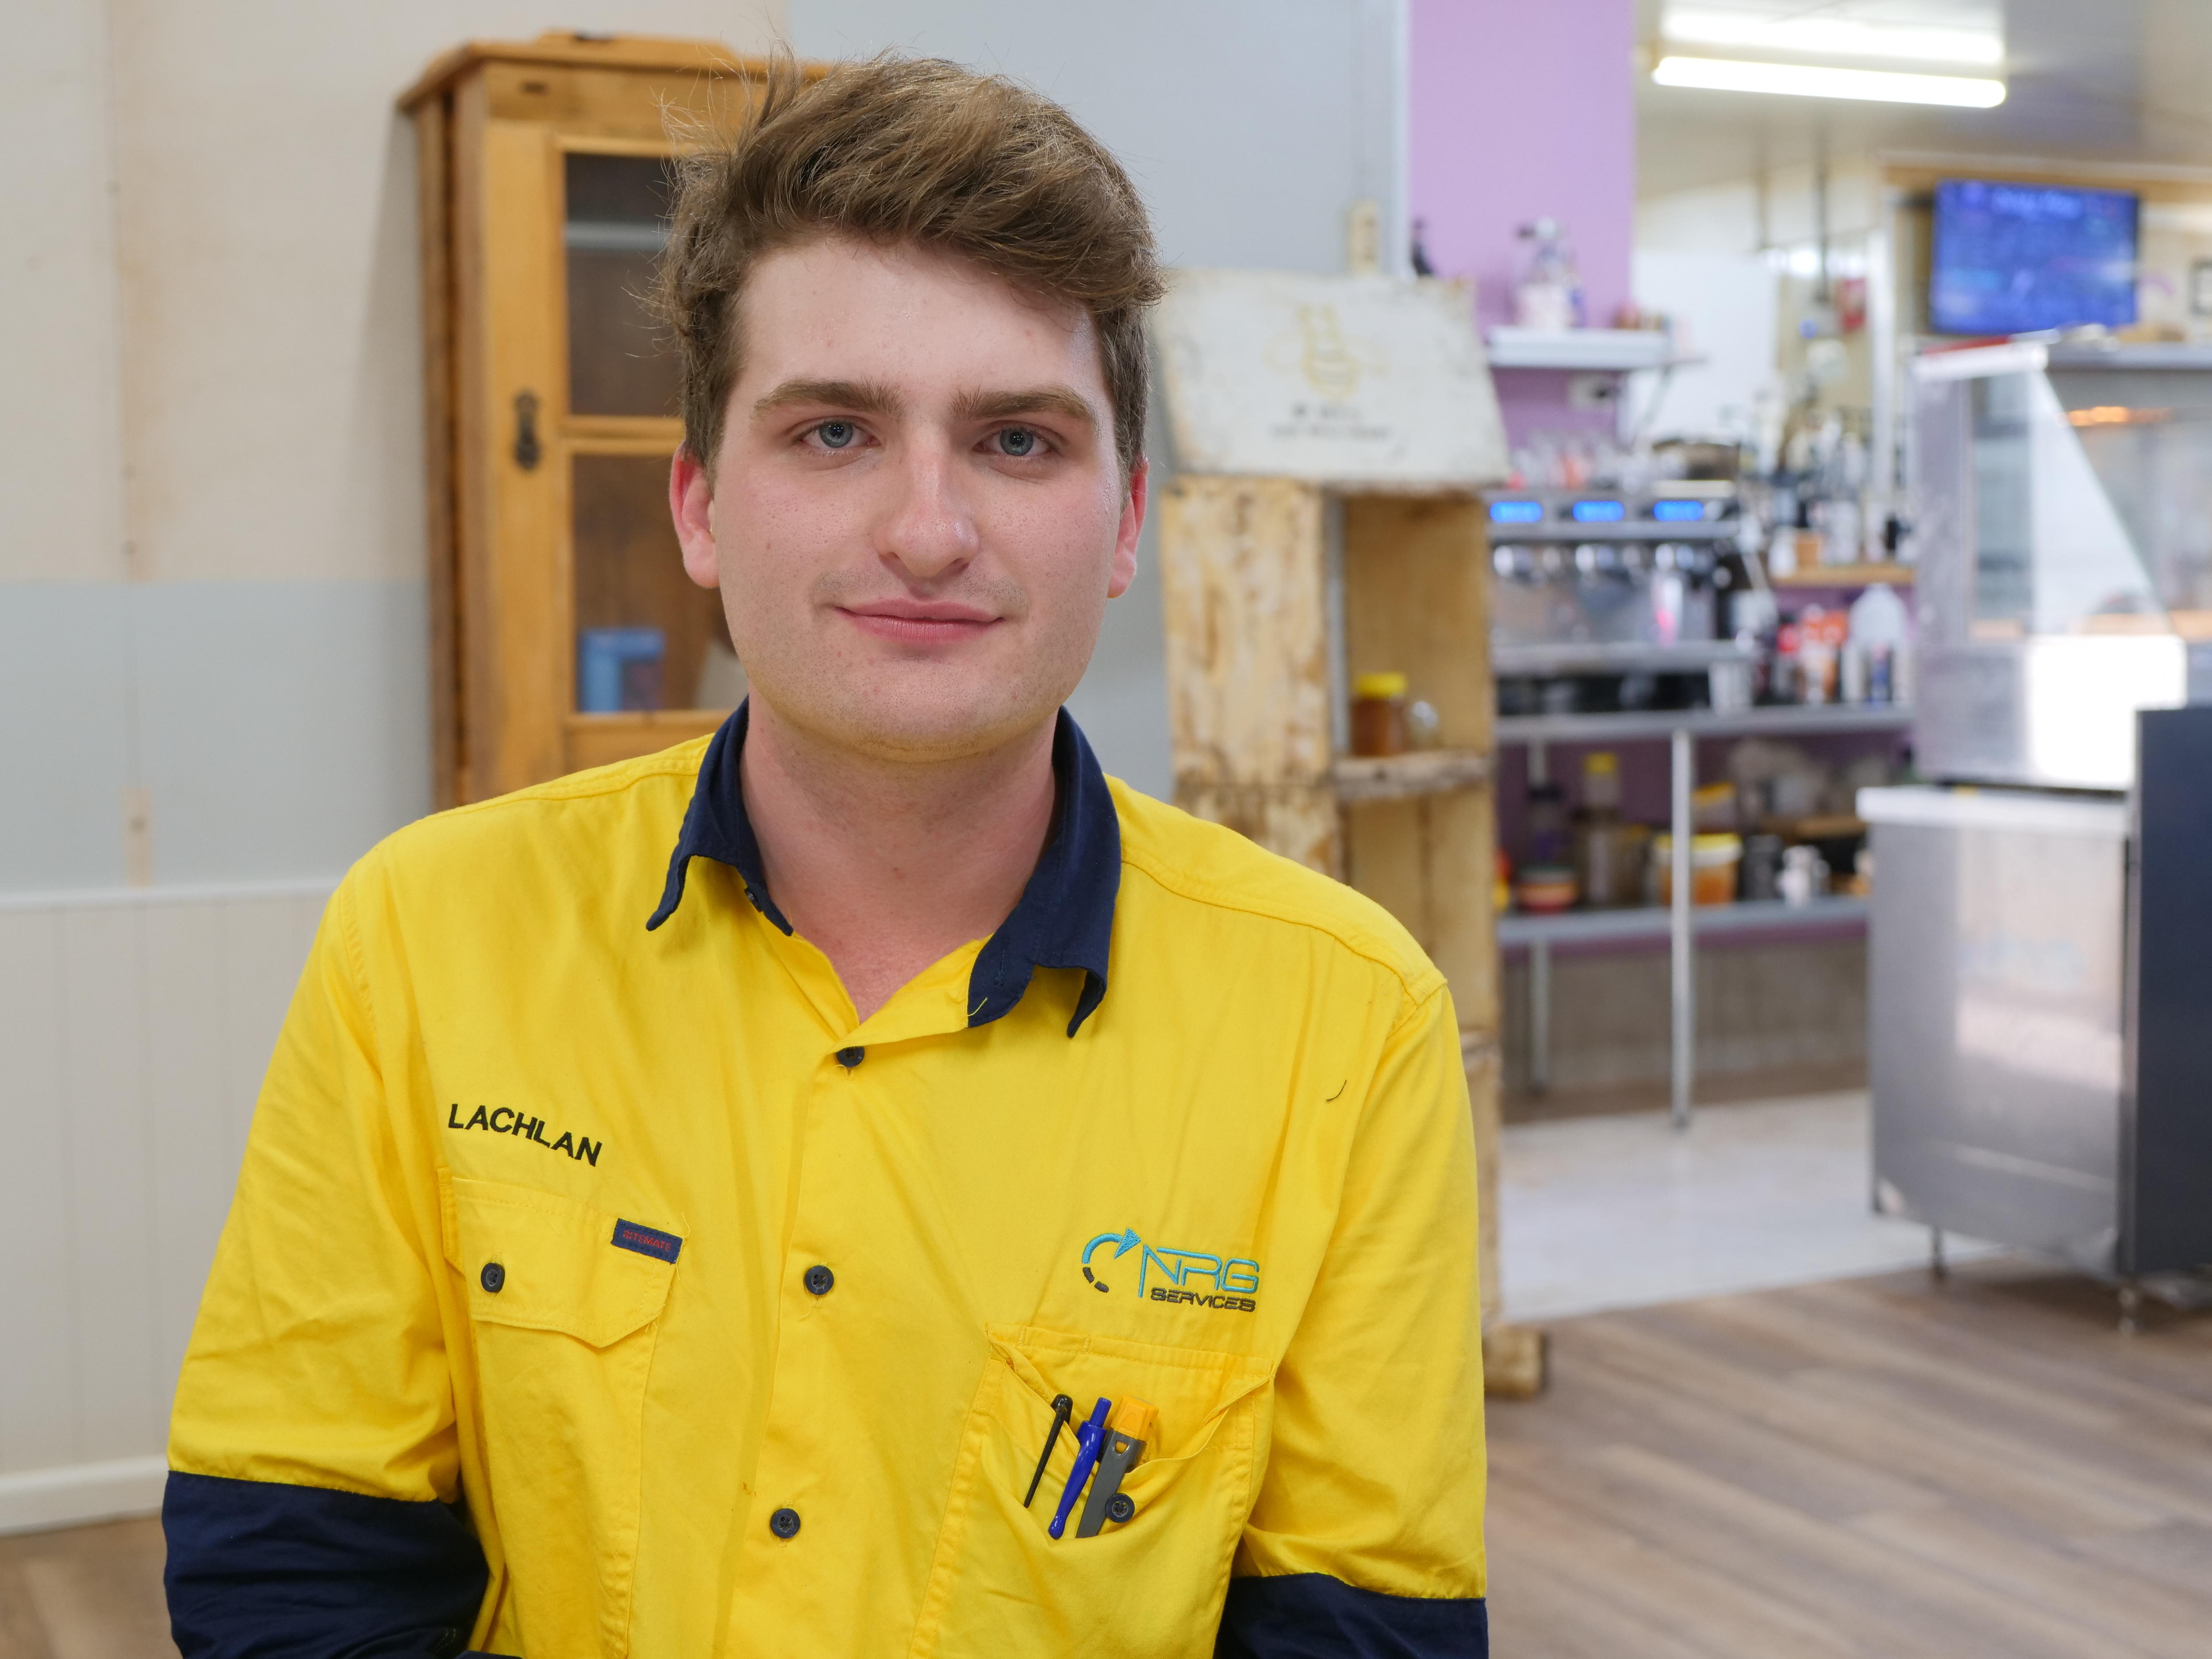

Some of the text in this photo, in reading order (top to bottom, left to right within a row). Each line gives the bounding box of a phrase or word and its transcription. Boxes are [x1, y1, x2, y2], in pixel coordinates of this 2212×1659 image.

[448, 1103, 603, 1167] LACHLAN
[622, 1229, 672, 1252] RITEMATE
[1138, 1244, 1260, 1298] NRG
[1150, 1287, 1256, 1312] SERVICES
